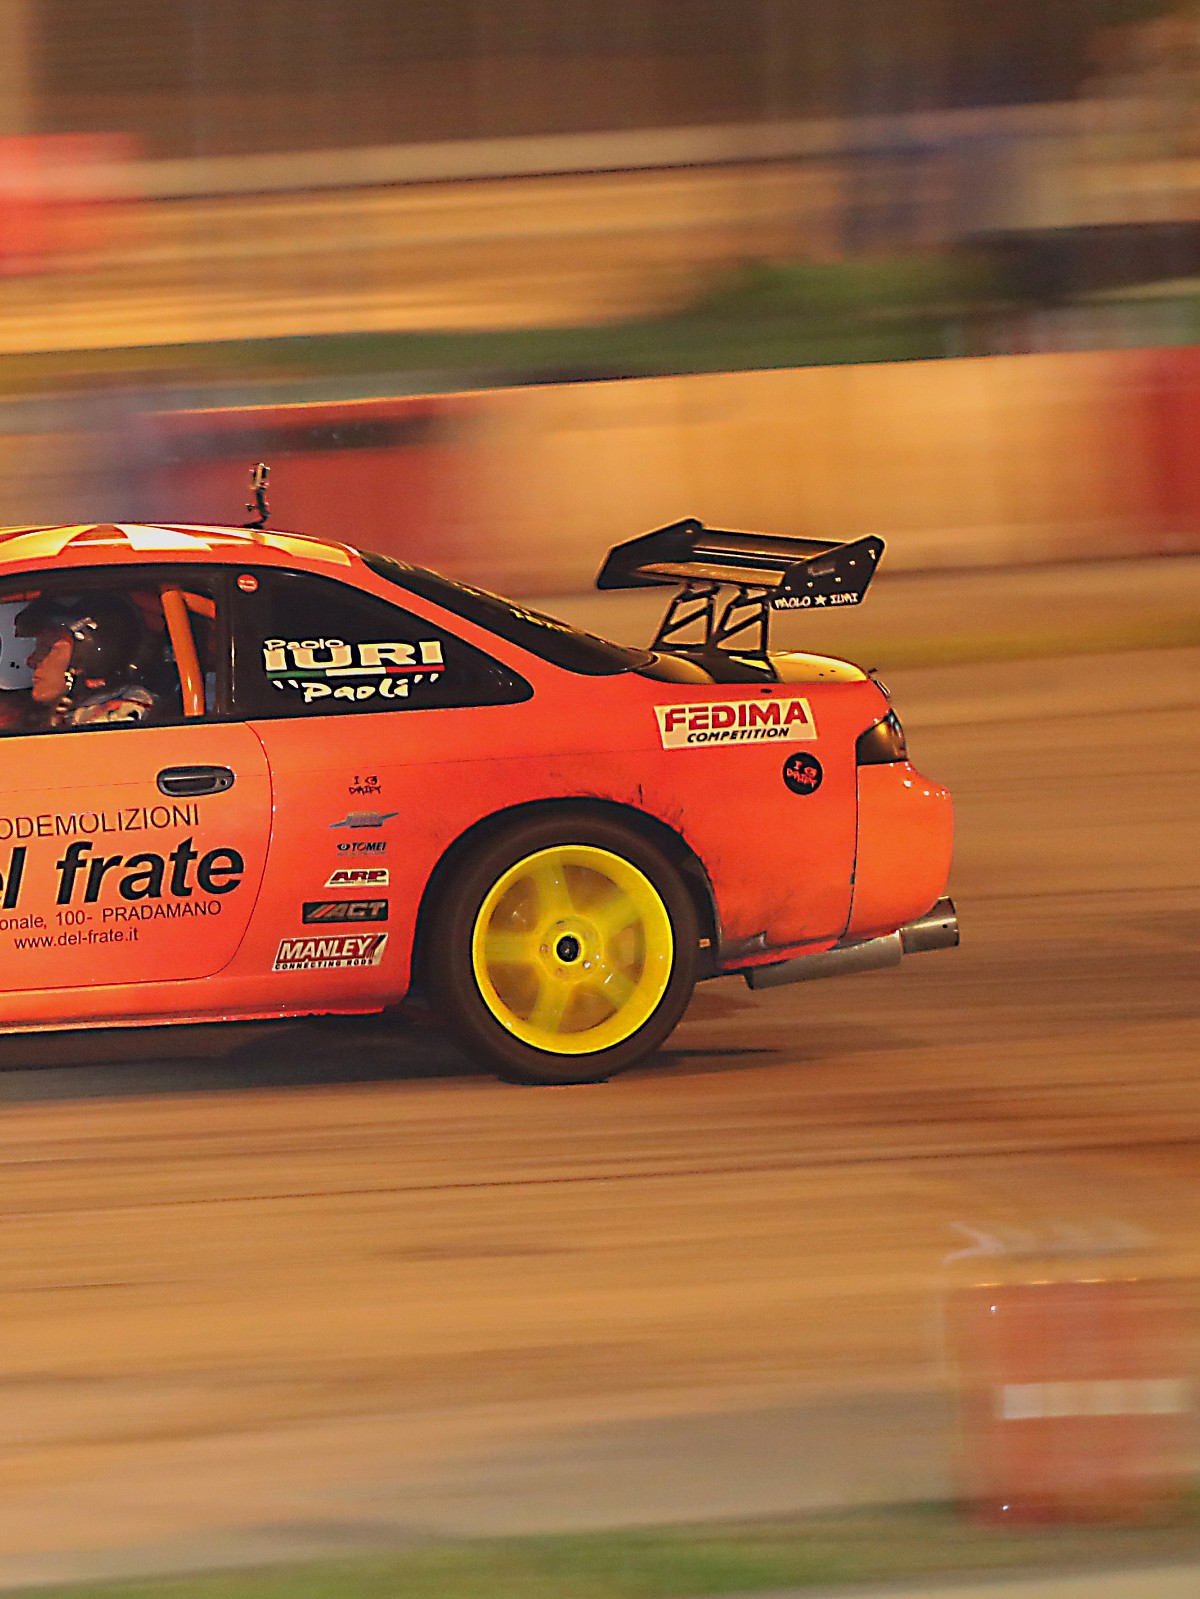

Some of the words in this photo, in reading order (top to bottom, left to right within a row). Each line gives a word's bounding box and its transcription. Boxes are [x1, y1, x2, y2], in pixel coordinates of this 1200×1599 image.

[263, 641, 444, 671] IURI
[264, 639, 344, 650] Paolo
[665, 700, 808, 732] FEDIMA
[687, 727, 790, 743] COMPETITION
[351, 842, 387, 852] TOMEI
[55, 836, 244, 905] frate
[331, 870, 387, 881] ARP
[102, 900, 222, 923] PRADAMANO
[14, 927, 139, 950] www.del-frate.it
[279, 935, 370, 960] MANLEY
[275, 959, 341, 970] CONNECTING
